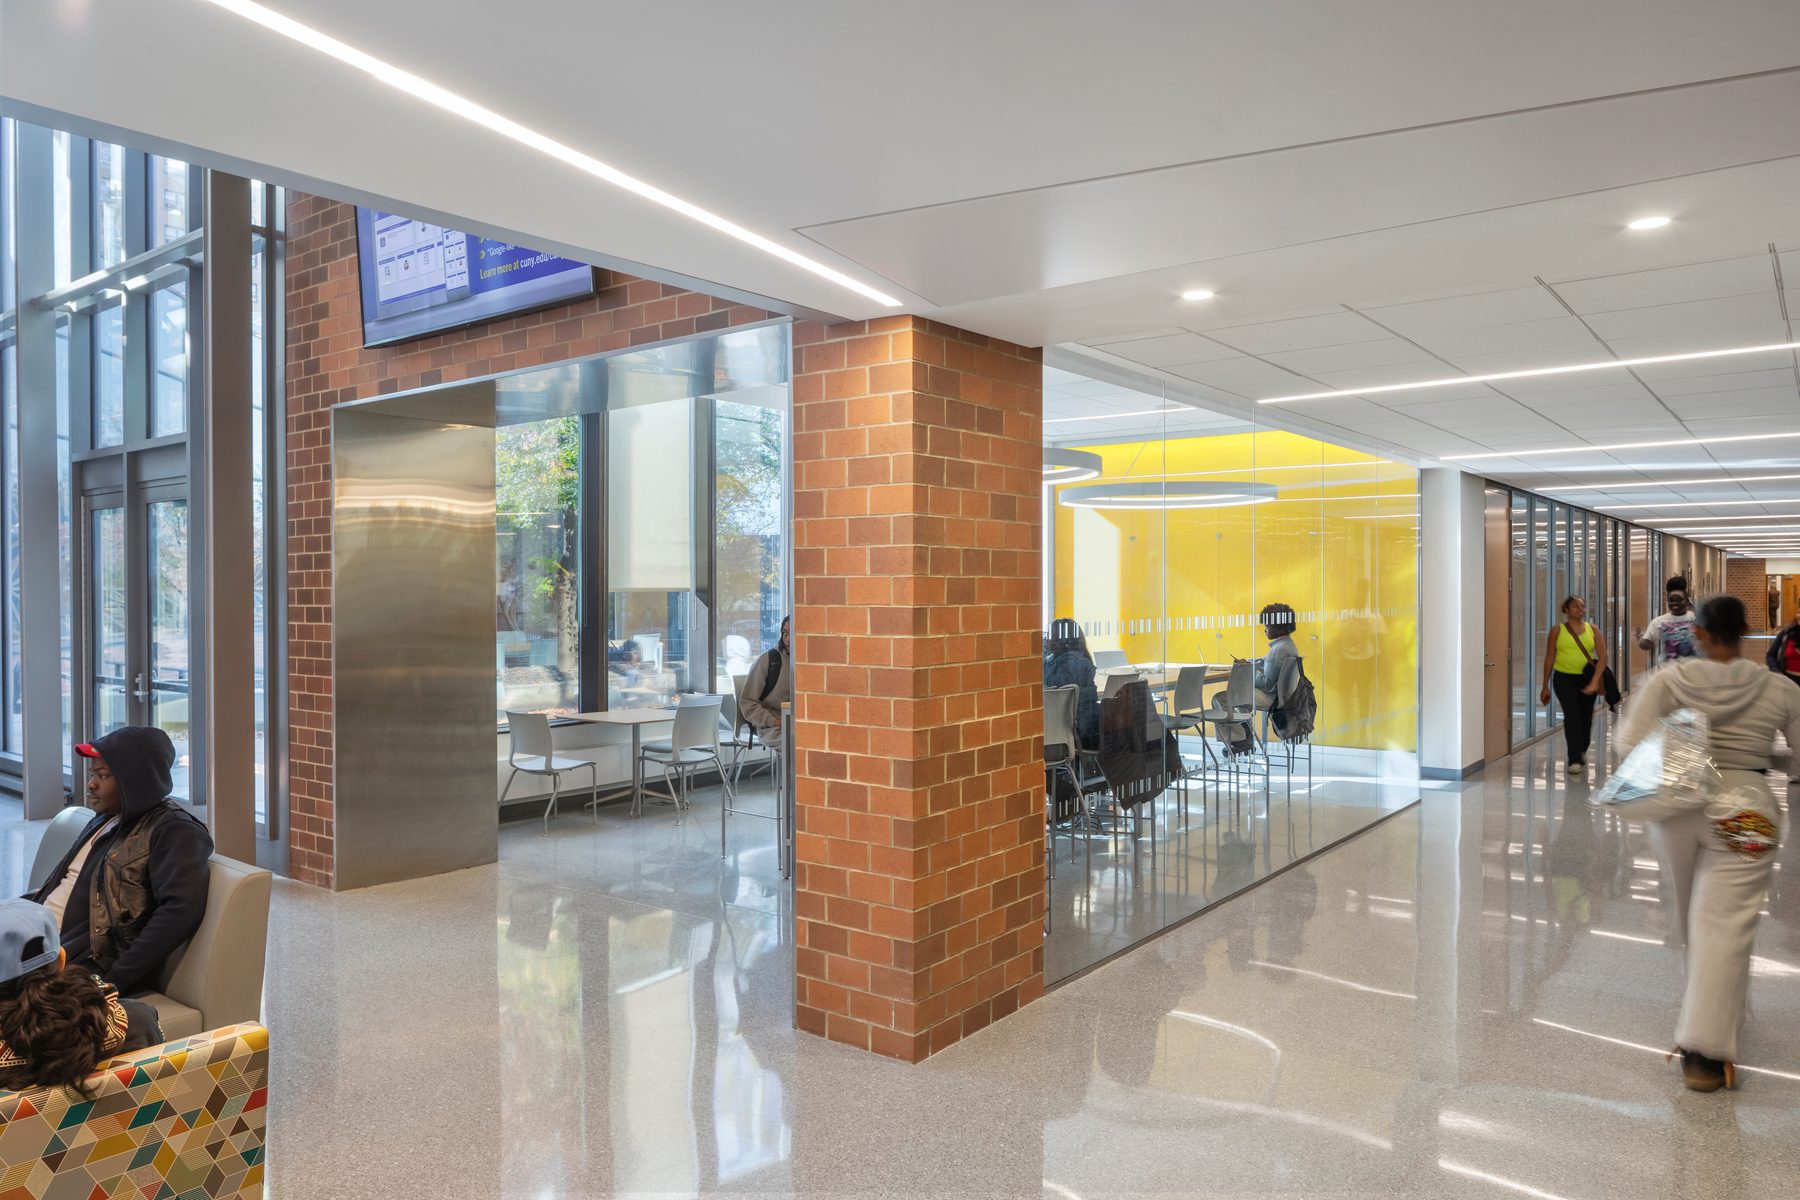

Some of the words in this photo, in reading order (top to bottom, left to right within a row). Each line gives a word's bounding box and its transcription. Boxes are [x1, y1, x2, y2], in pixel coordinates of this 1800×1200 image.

[480, 268, 496, 280] Learn
[496, 264, 512, 275] more
[513, 259, 520, 270] at
